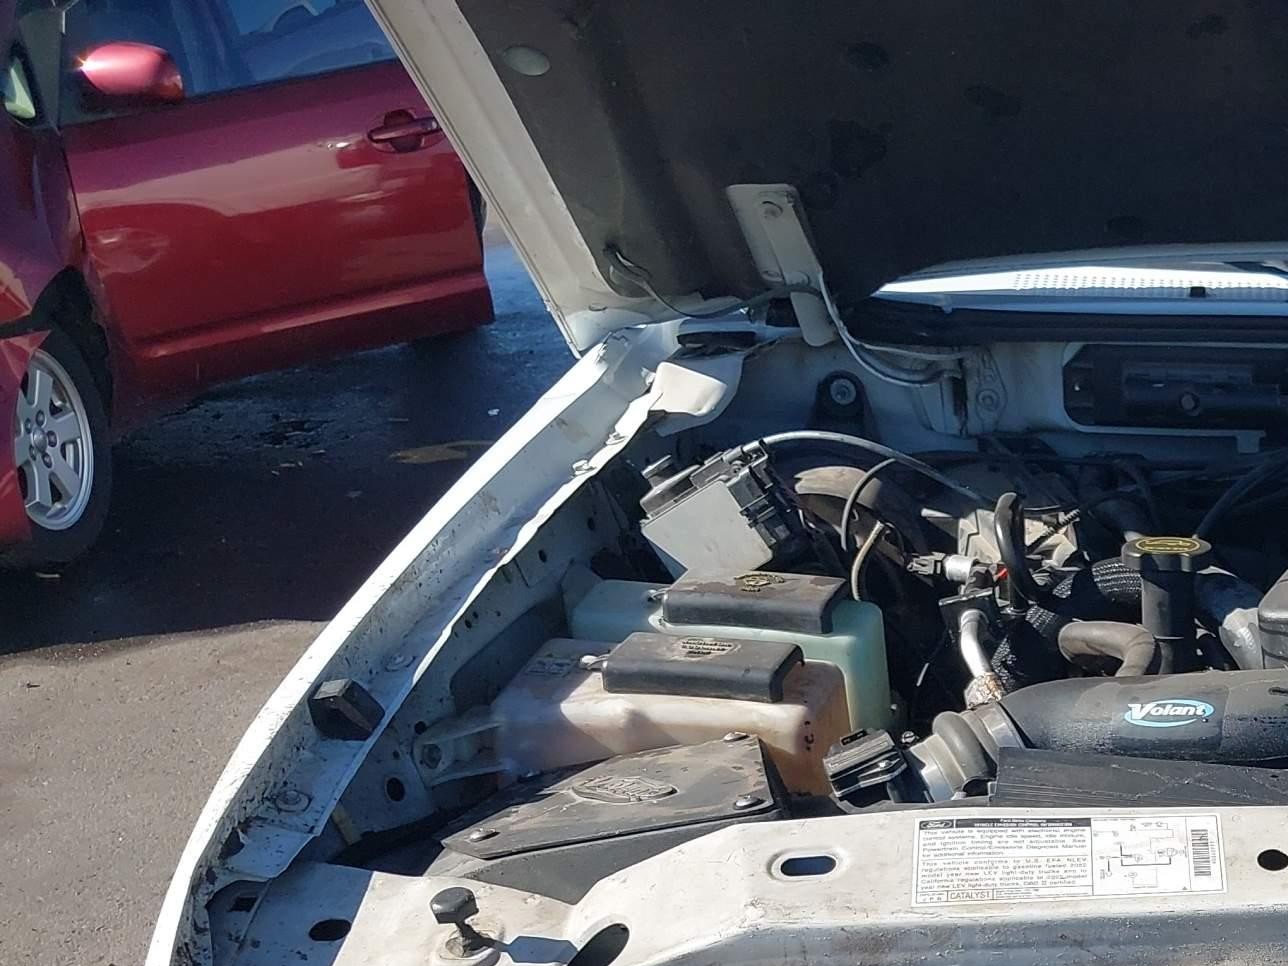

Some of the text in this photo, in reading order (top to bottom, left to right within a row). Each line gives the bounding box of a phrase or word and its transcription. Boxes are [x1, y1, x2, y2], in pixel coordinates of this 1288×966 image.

[1127, 703, 1206, 720] Volant
[926, 820, 946, 829] Ford
[950, 891, 991, 900] CATALYST
